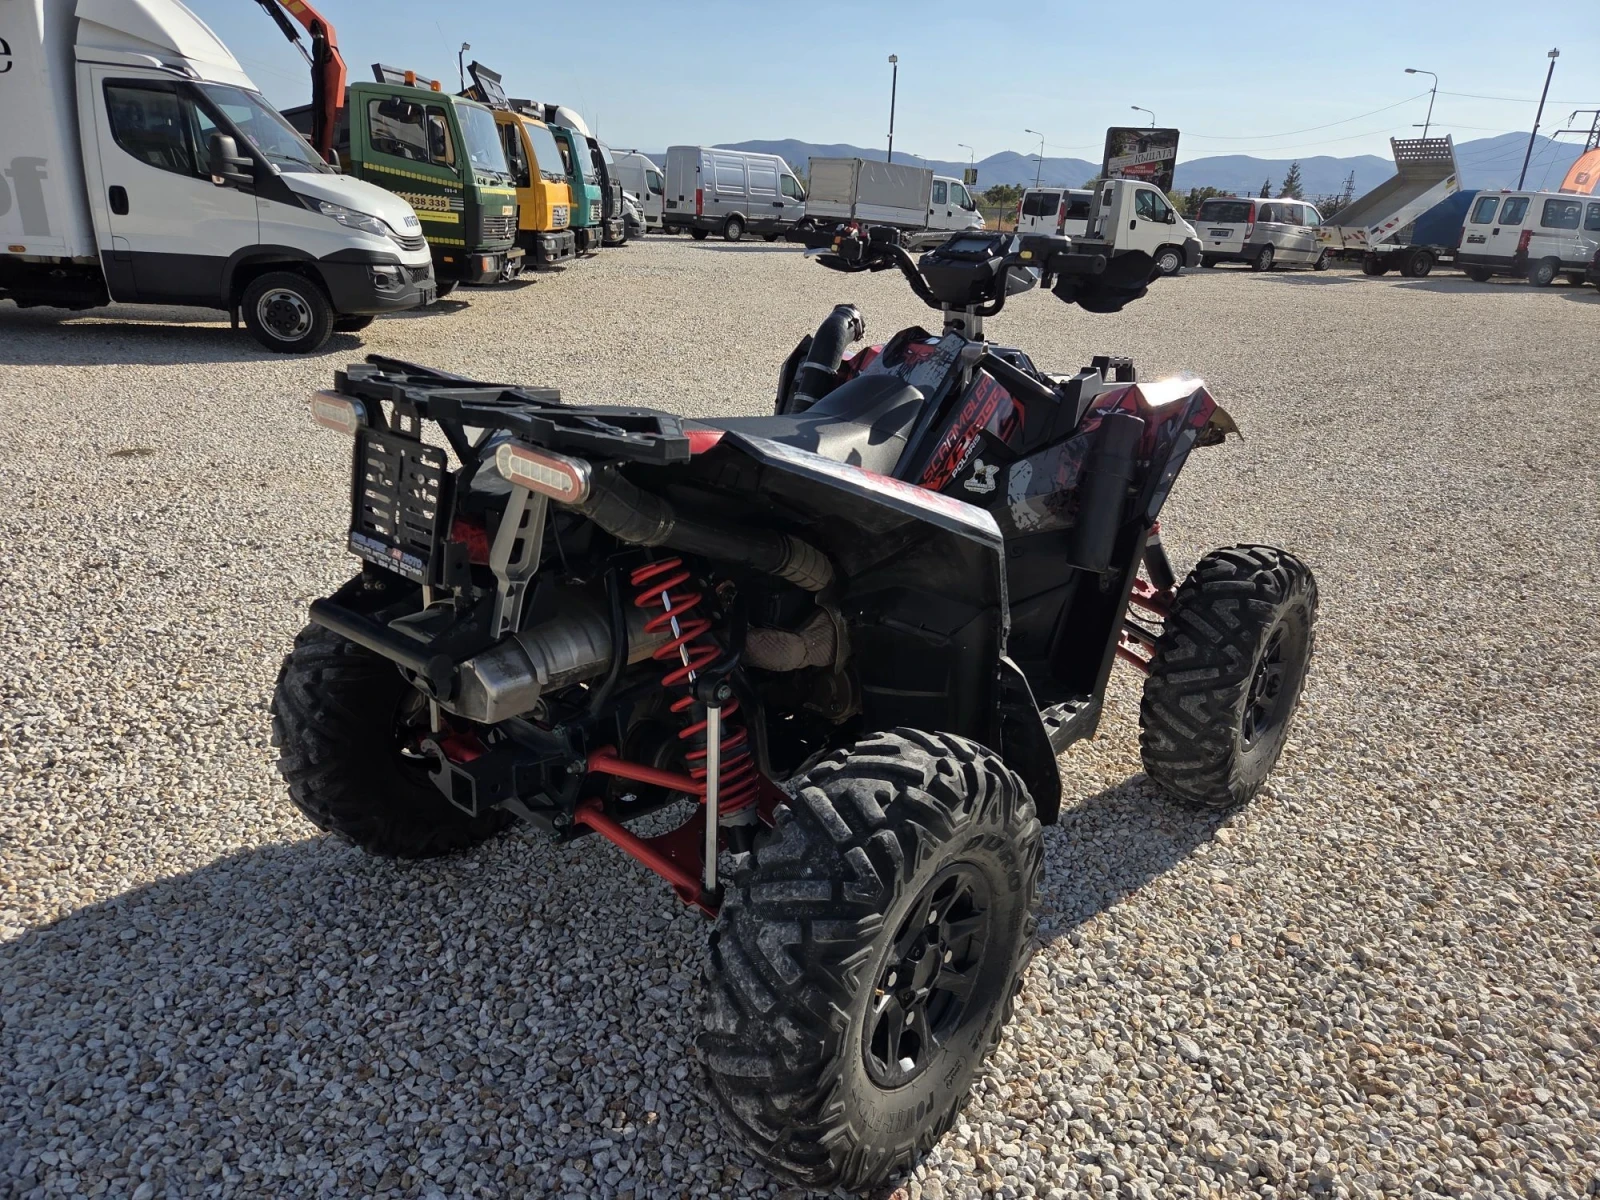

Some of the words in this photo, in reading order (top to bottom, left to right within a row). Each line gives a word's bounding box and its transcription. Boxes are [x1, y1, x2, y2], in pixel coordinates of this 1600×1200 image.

[409, 197, 426, 206] 438
[428, 198, 446, 207] 338
[923, 375, 993, 481] SCRAMBLER
[951, 434, 981, 478] POLARIS
[960, 833, 1021, 892] DURO
